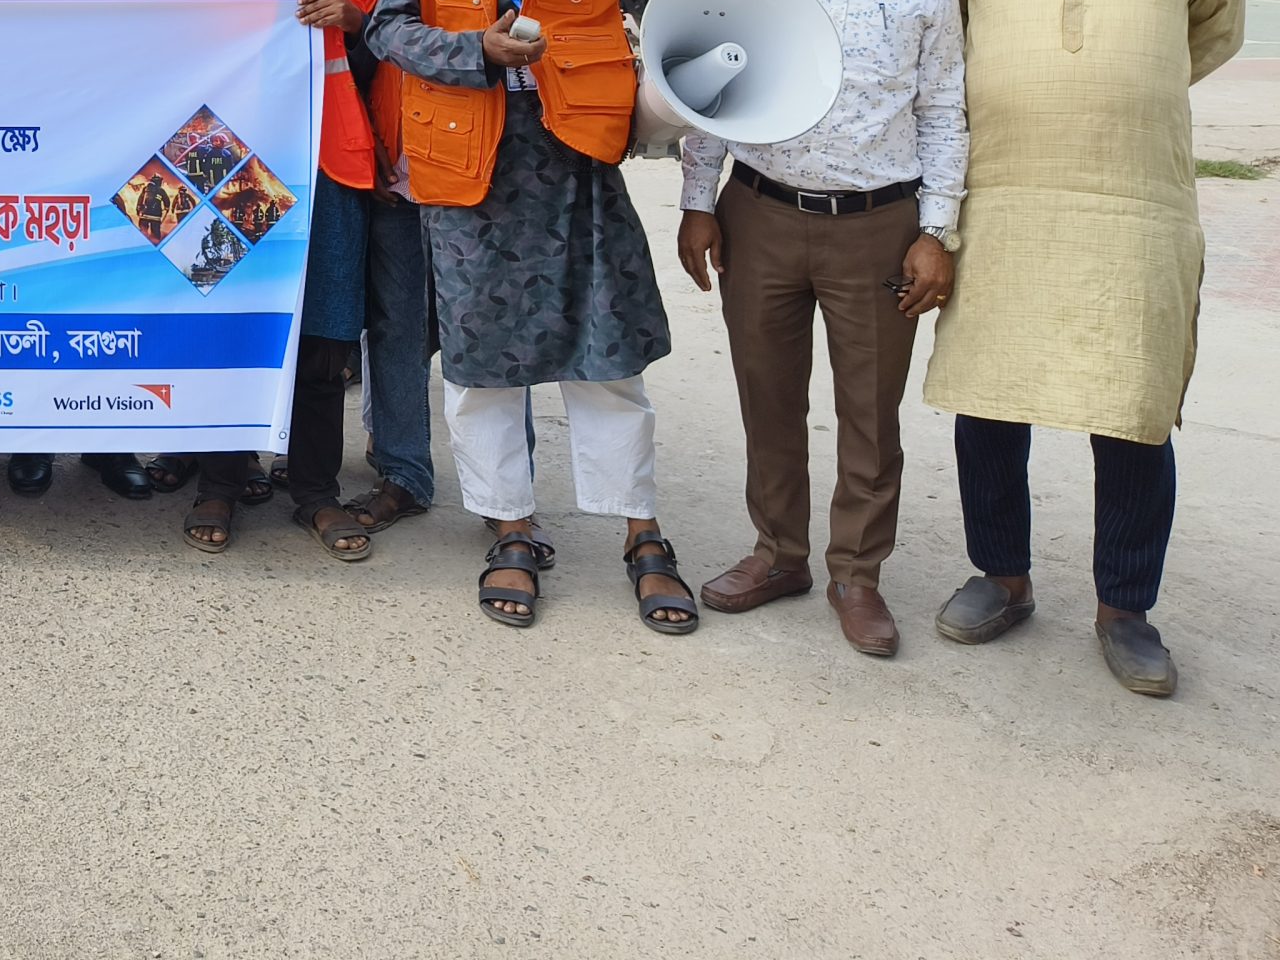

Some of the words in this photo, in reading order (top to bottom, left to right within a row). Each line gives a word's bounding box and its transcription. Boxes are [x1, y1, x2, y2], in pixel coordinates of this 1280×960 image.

[24, 195, 91, 252] মহড়া
[67, 326, 142, 359] বরগুনা
[53, 395, 101, 411] World
[105, 395, 154, 411] Vision
